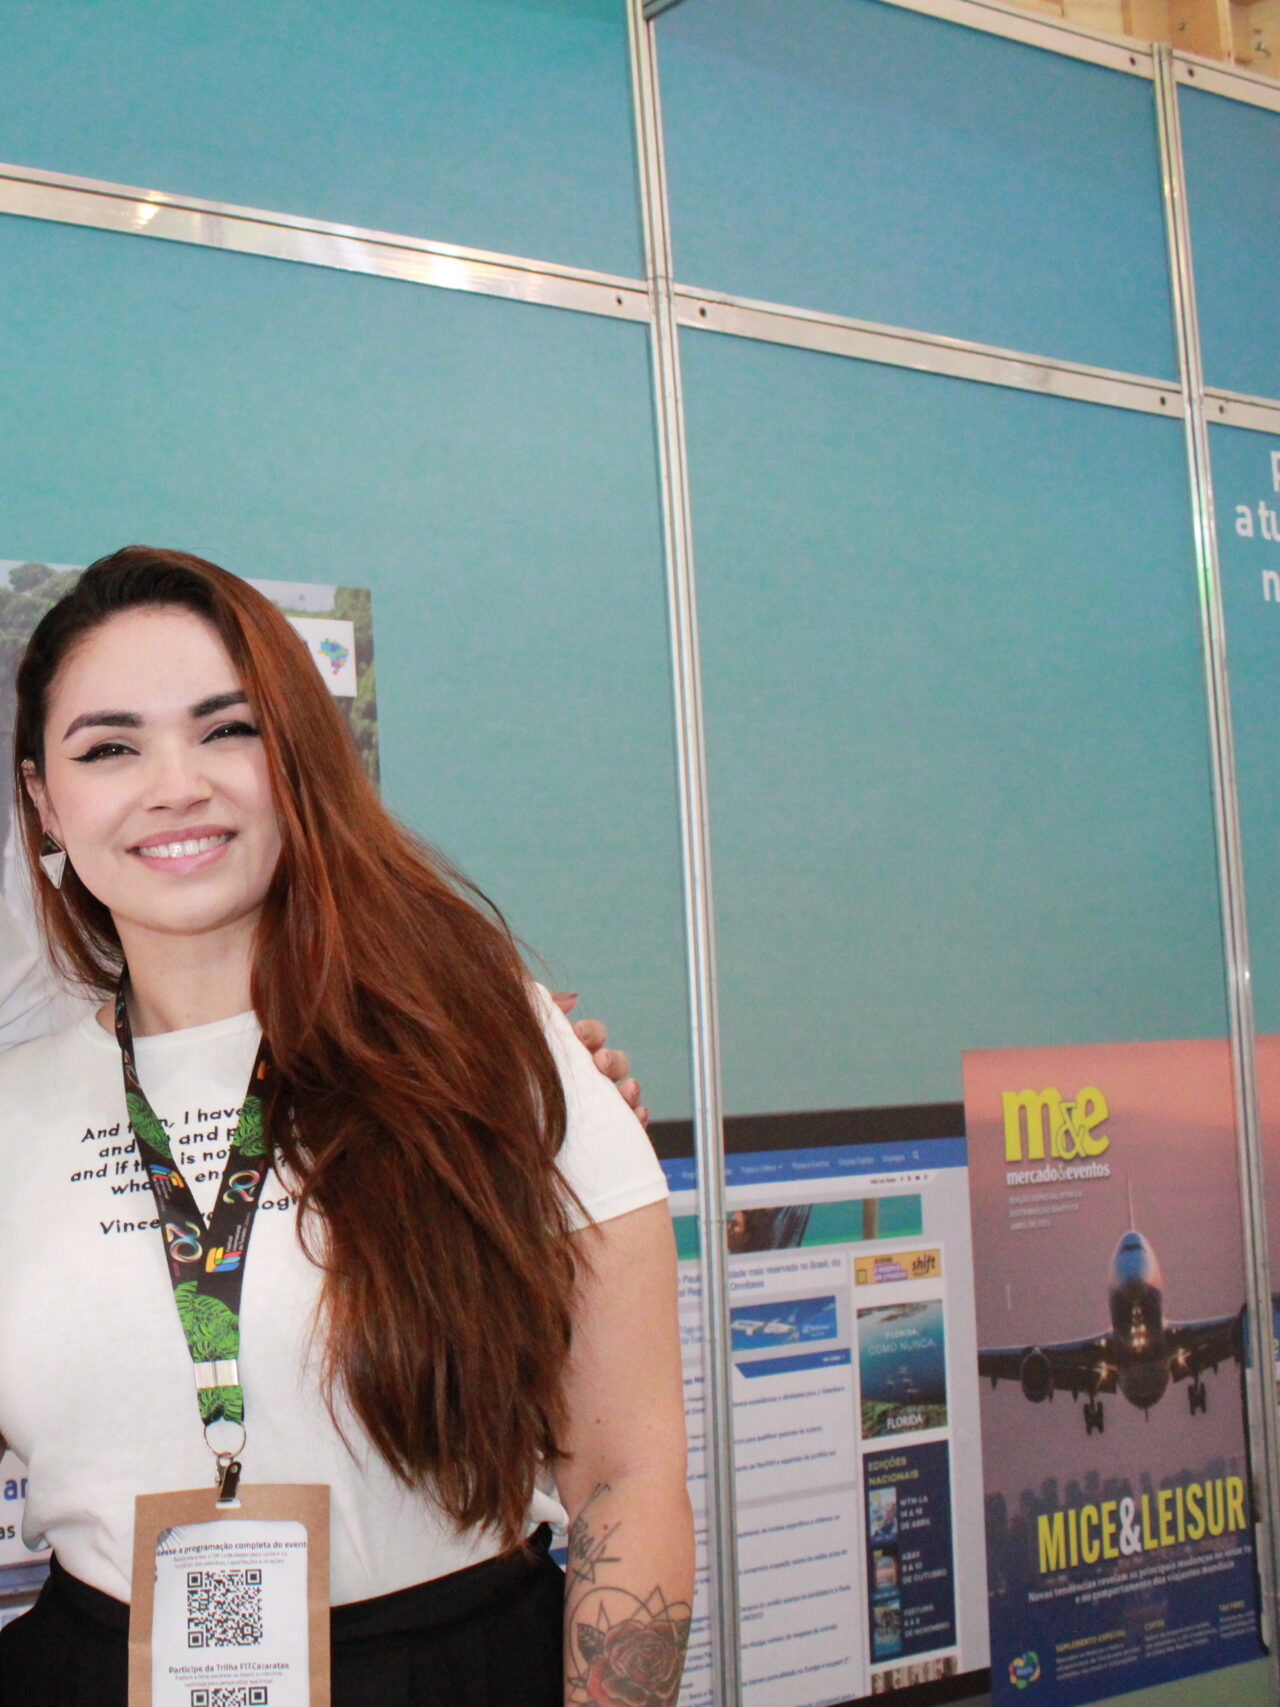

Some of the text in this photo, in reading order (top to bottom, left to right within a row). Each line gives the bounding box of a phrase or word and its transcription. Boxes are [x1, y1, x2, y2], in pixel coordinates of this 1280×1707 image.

[81, 1123, 120, 1143] And
[184, 1111, 189, 1124] I
[1001, 1086, 1110, 1162] m&e
[99, 1139, 136, 1157] and
[179, 1126, 219, 1145] and
[71, 1163, 108, 1182] and
[115, 1160, 129, 1175] if
[181, 1152, 195, 1165] is
[1006, 1161, 1111, 1186] mercado&eventos
[886, 1413, 924, 1430] FLORIDA
[868, 1469, 920, 1485] NACIONAIS
[184, 1541, 233, 1555] programação
[235, 1540, 271, 1550] completa
[272, 1540, 283, 1549] do
[169, 1663, 203, 1674] Participe
[205, 1663, 215, 1672] da
[216, 1662, 238, 1672] Trilha
